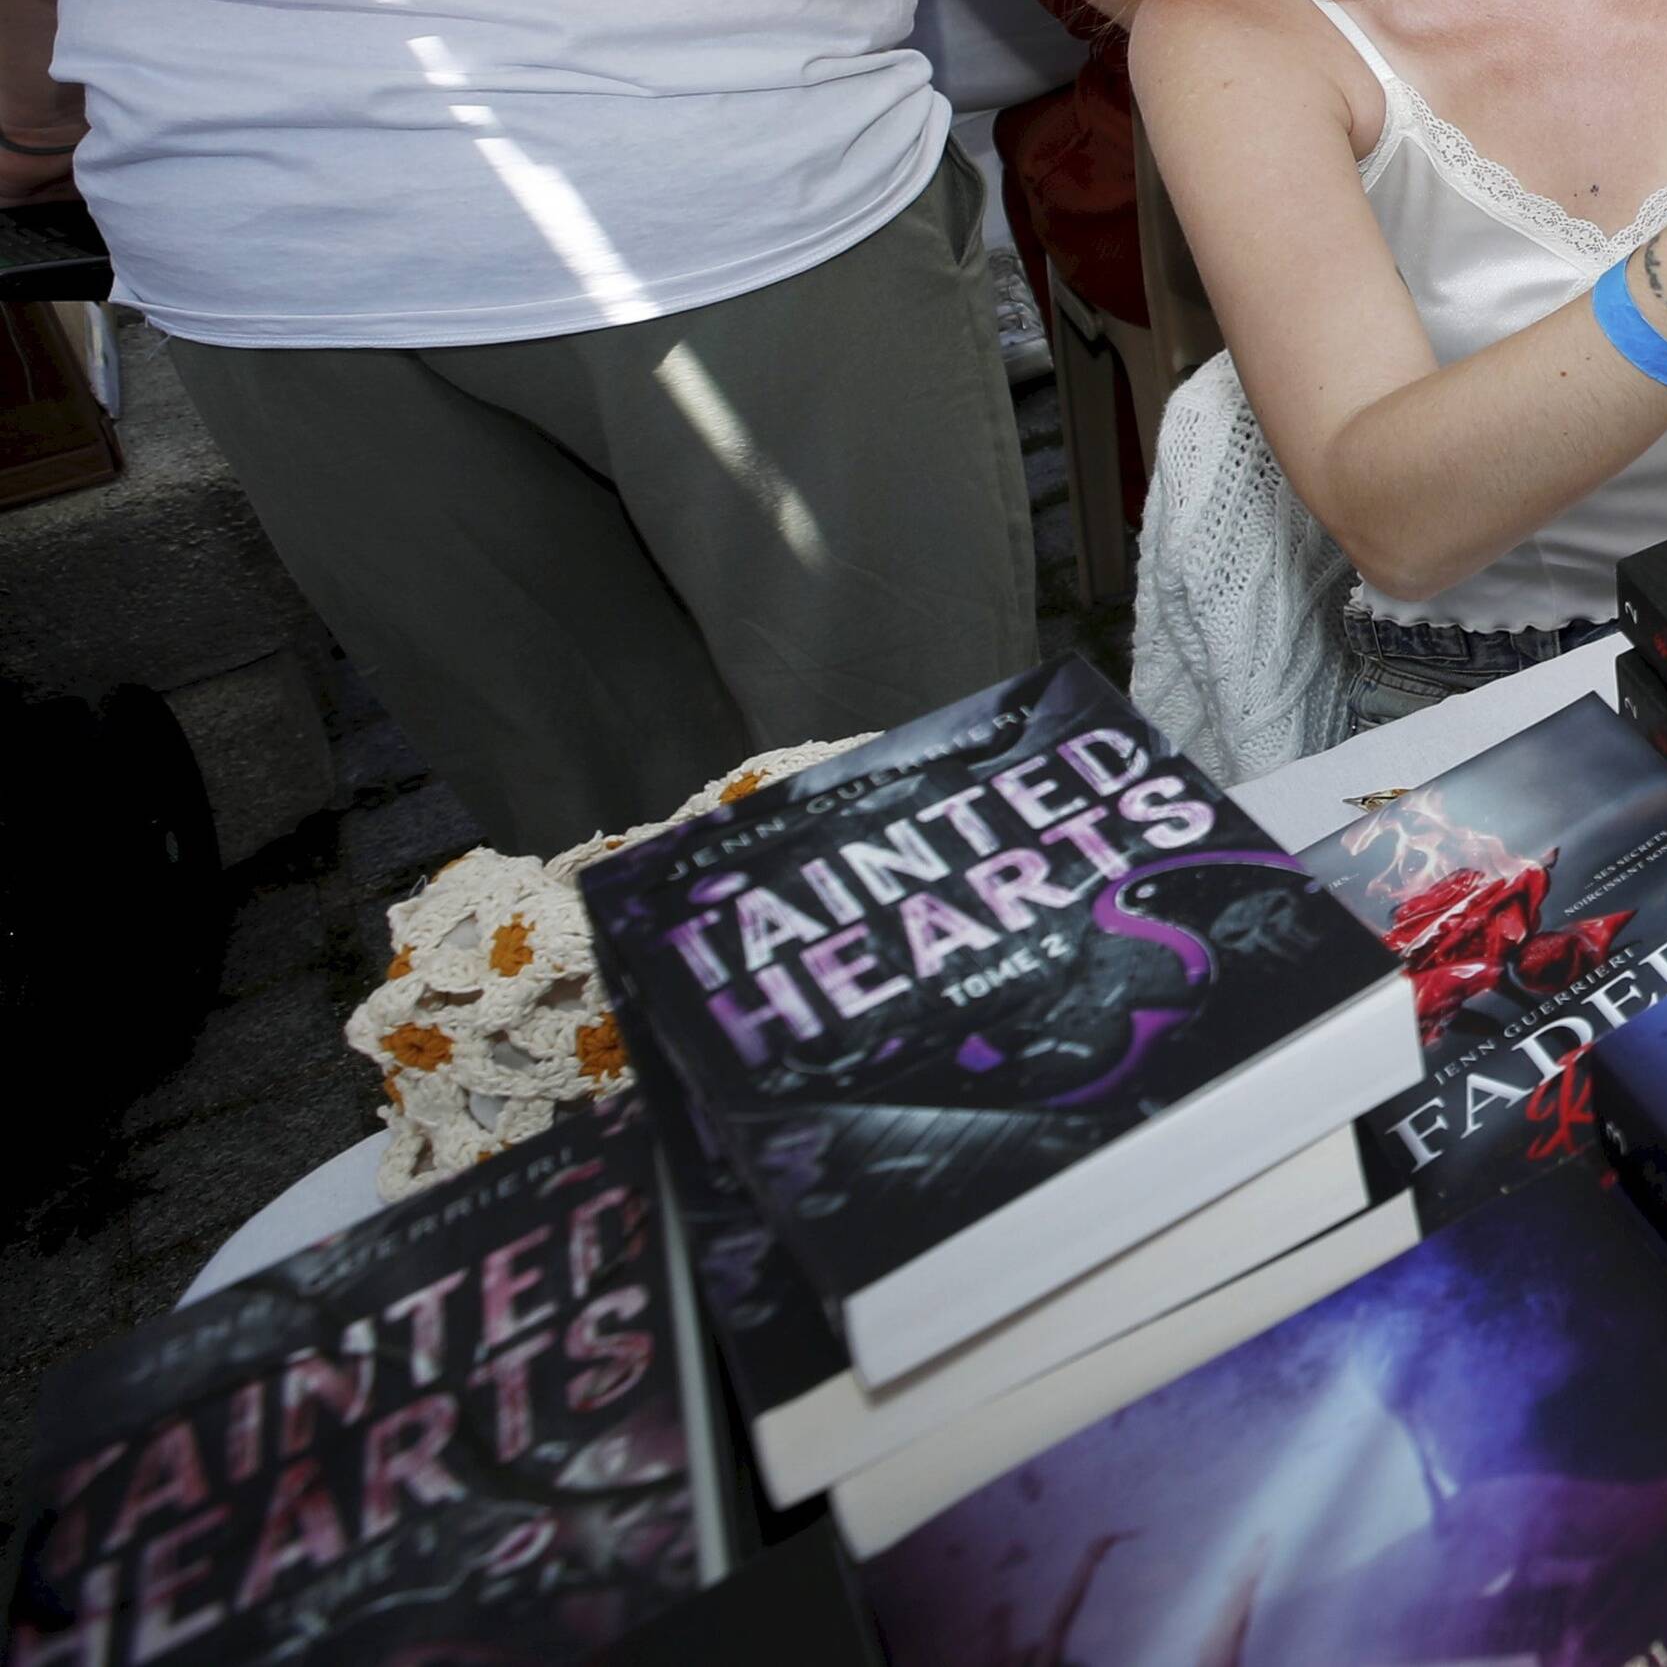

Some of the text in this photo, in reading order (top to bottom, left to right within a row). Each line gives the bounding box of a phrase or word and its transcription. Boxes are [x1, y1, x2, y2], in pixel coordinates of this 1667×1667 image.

[1624, 601, 1638, 625] 2
[668, 704, 1032, 882] JENN GUERRIERI
[658, 727, 1151, 993] TAINTED
[1563, 860, 1645, 916] NOIRCISSENT
[1592, 864, 1617, 881] SES
[707, 774, 1216, 1071] HEARTS
[940, 932, 1073, 1008] TOME 2
[1432, 945, 1637, 1087] JENN GUERRIERI
